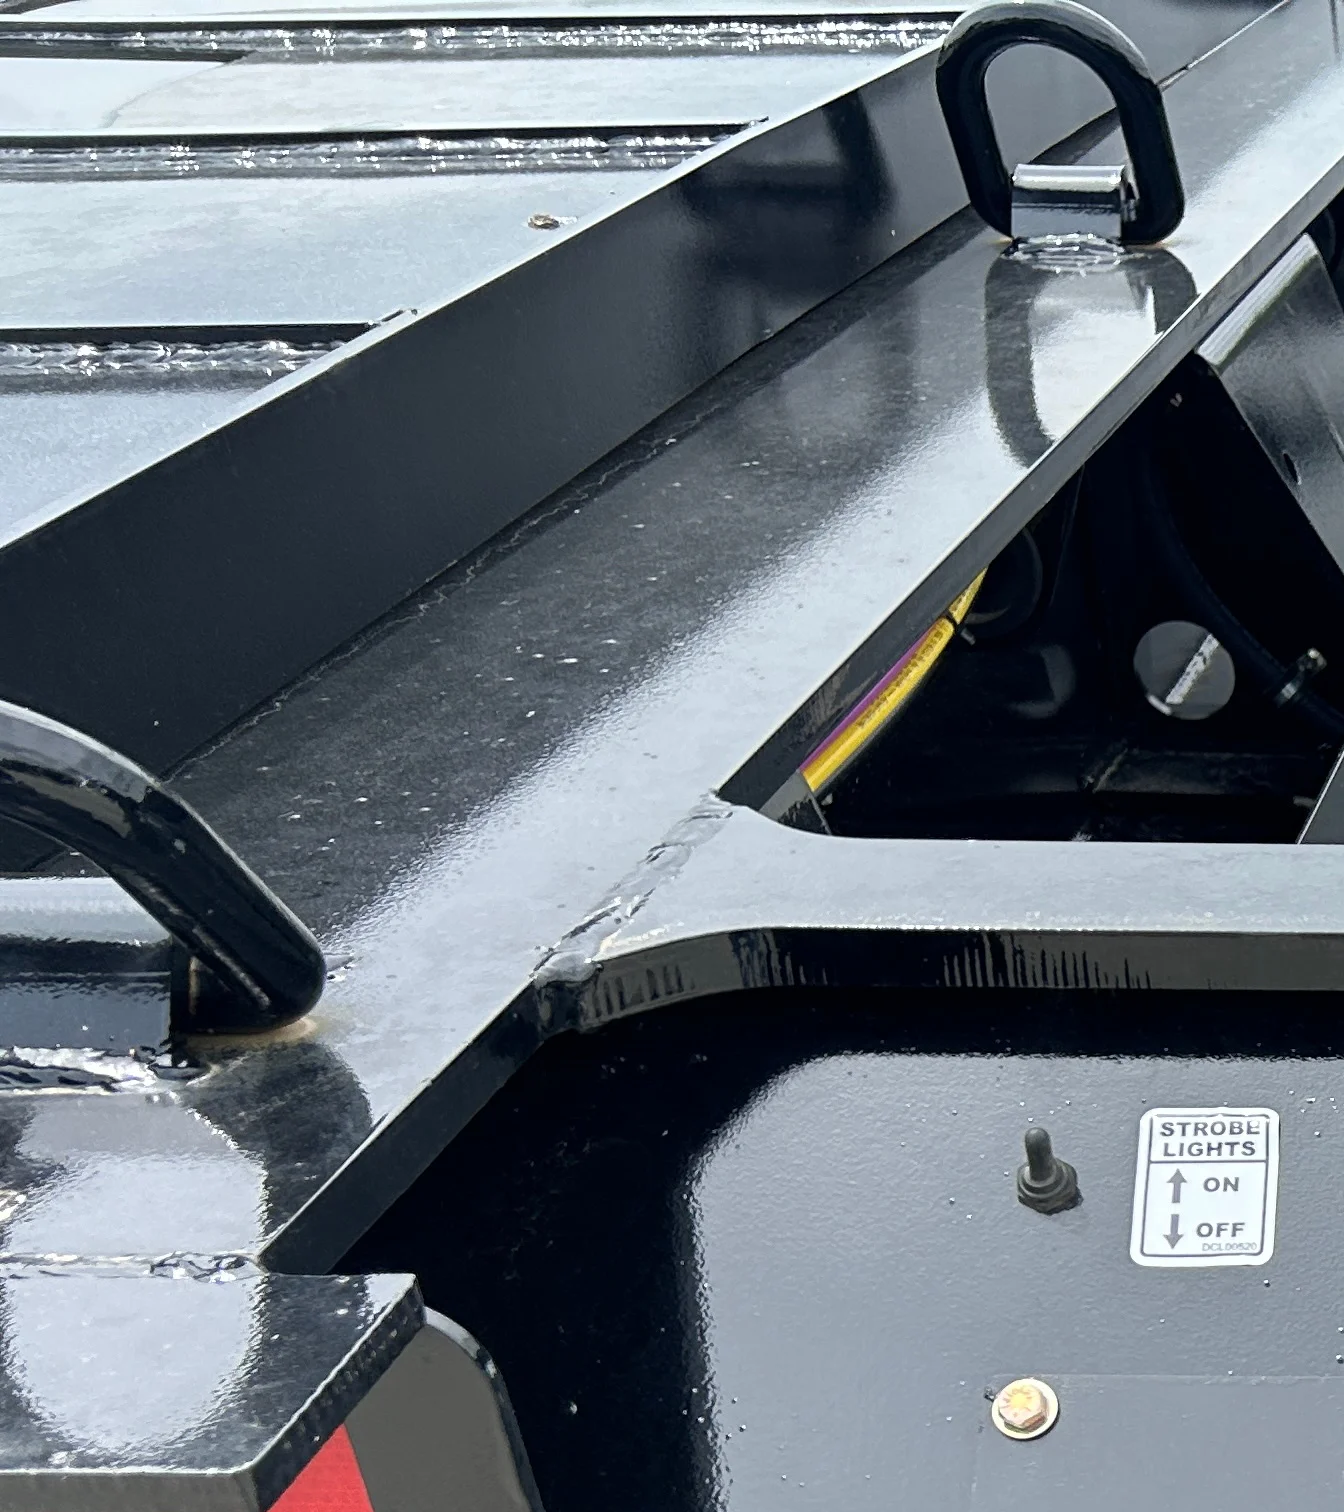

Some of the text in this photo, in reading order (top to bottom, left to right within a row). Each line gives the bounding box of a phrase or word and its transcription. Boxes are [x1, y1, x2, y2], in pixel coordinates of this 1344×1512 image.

[1160, 1120, 1260, 1136] STROBE
[1163, 1141, 1256, 1156] LIGHTS
[1203, 1177, 1240, 1192] ON
[1196, 1223, 1245, 1237] OFF
